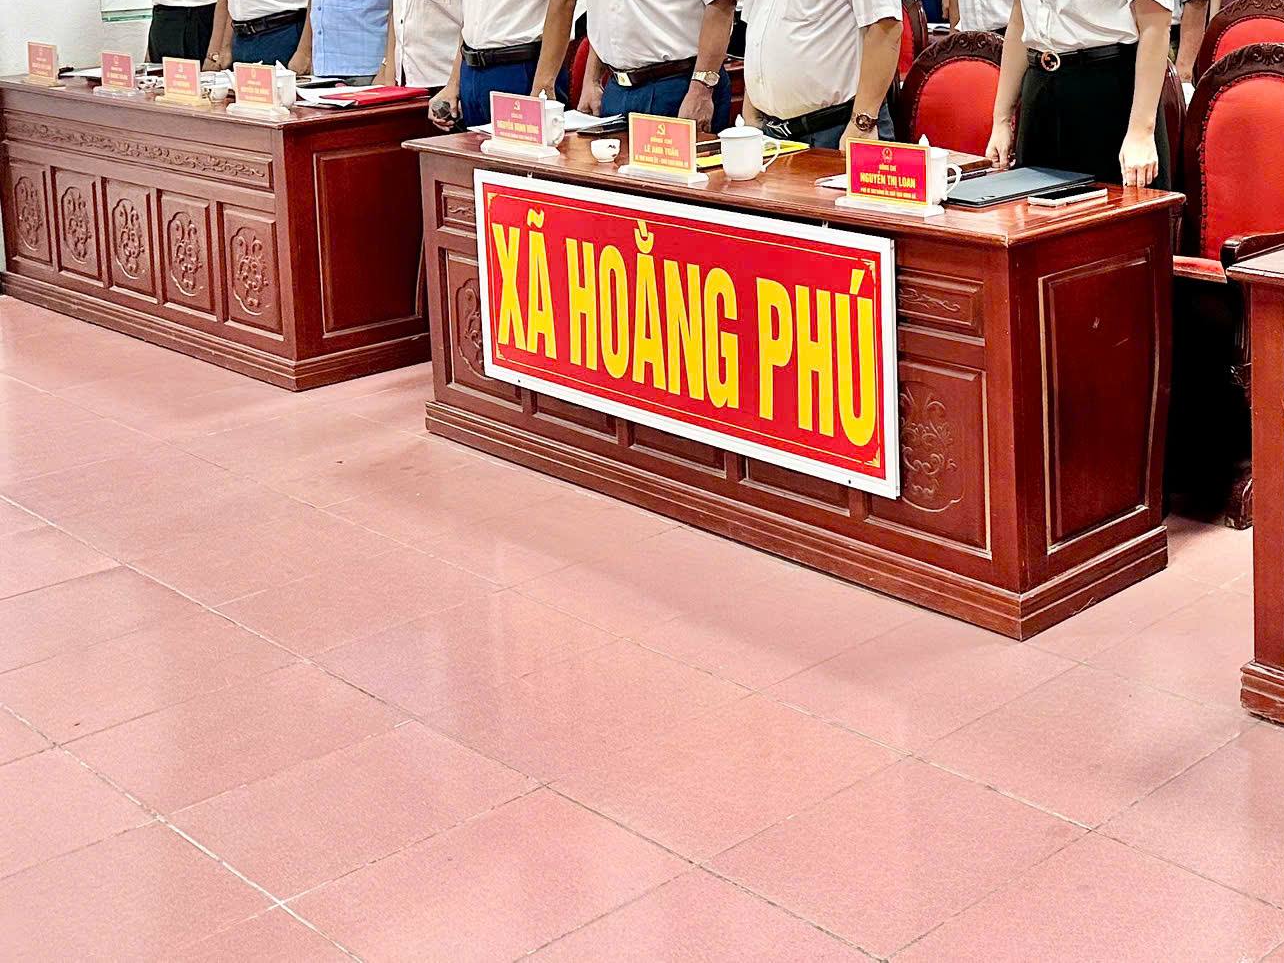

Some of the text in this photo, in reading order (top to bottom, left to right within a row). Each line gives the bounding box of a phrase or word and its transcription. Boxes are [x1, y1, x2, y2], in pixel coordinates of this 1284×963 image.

[887, 175, 898, 188] THỊ
[899, 177, 916, 189] LOAN
[491, 208, 877, 447] XÃ HOẰNG PHÚ
